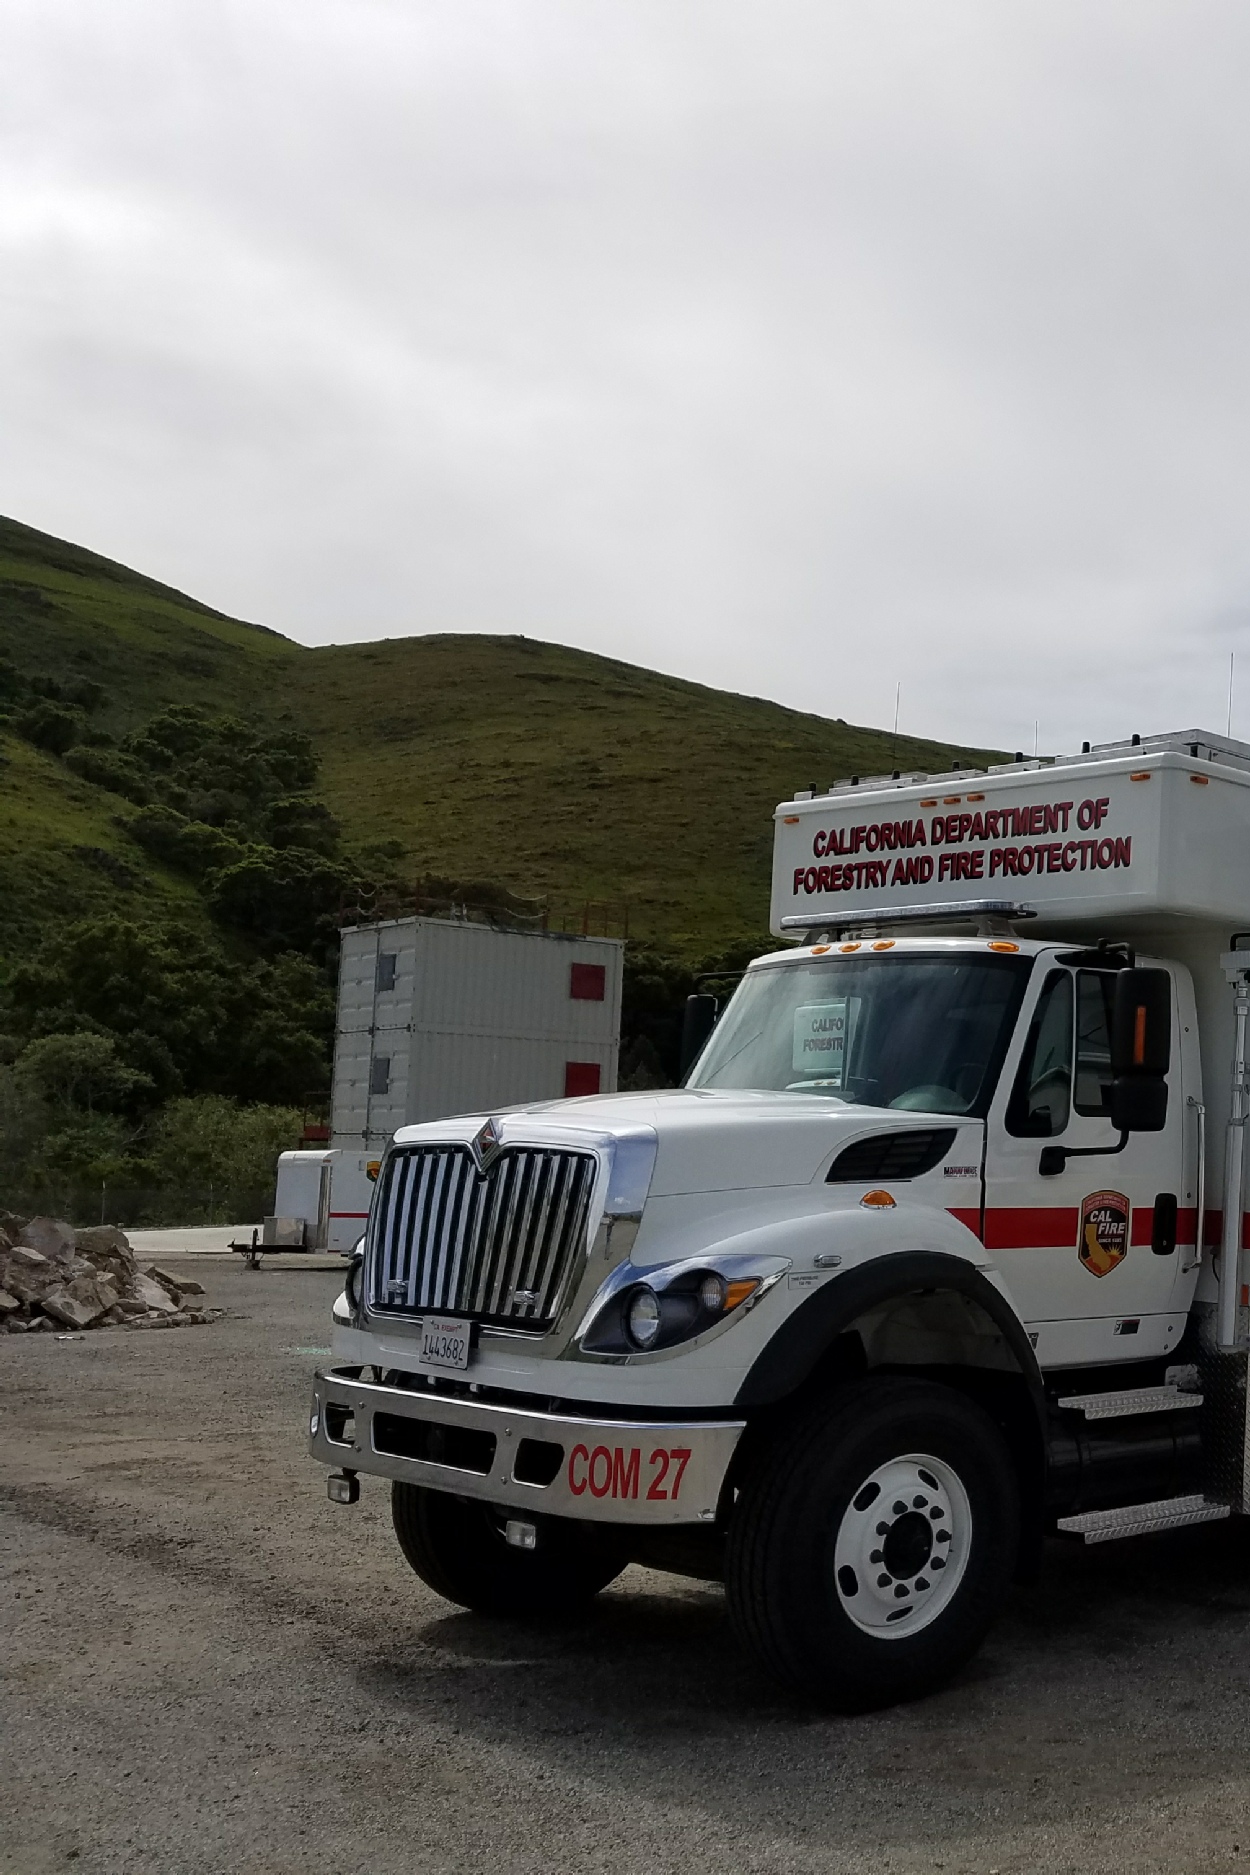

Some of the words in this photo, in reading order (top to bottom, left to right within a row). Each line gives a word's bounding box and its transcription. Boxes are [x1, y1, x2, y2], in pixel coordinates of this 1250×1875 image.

[813, 819, 926, 858] CALIFORNIA
[931, 801, 1073, 845] DEPARTMENT
[1077, 797, 1110, 831] OF
[793, 859, 892, 895] FORESTRY
[891, 855, 934, 887] AND
[938, 850, 984, 882] FIRE
[989, 836, 1132, 878] PROTECTION
[1090, 1210, 1112, 1222] CAL
[1098, 1222, 1126, 1235] FIRE
[422, 1334, 465, 1361] 1443682
[568, 1443, 641, 1499] COM
[646, 1448, 692, 1500] 27
